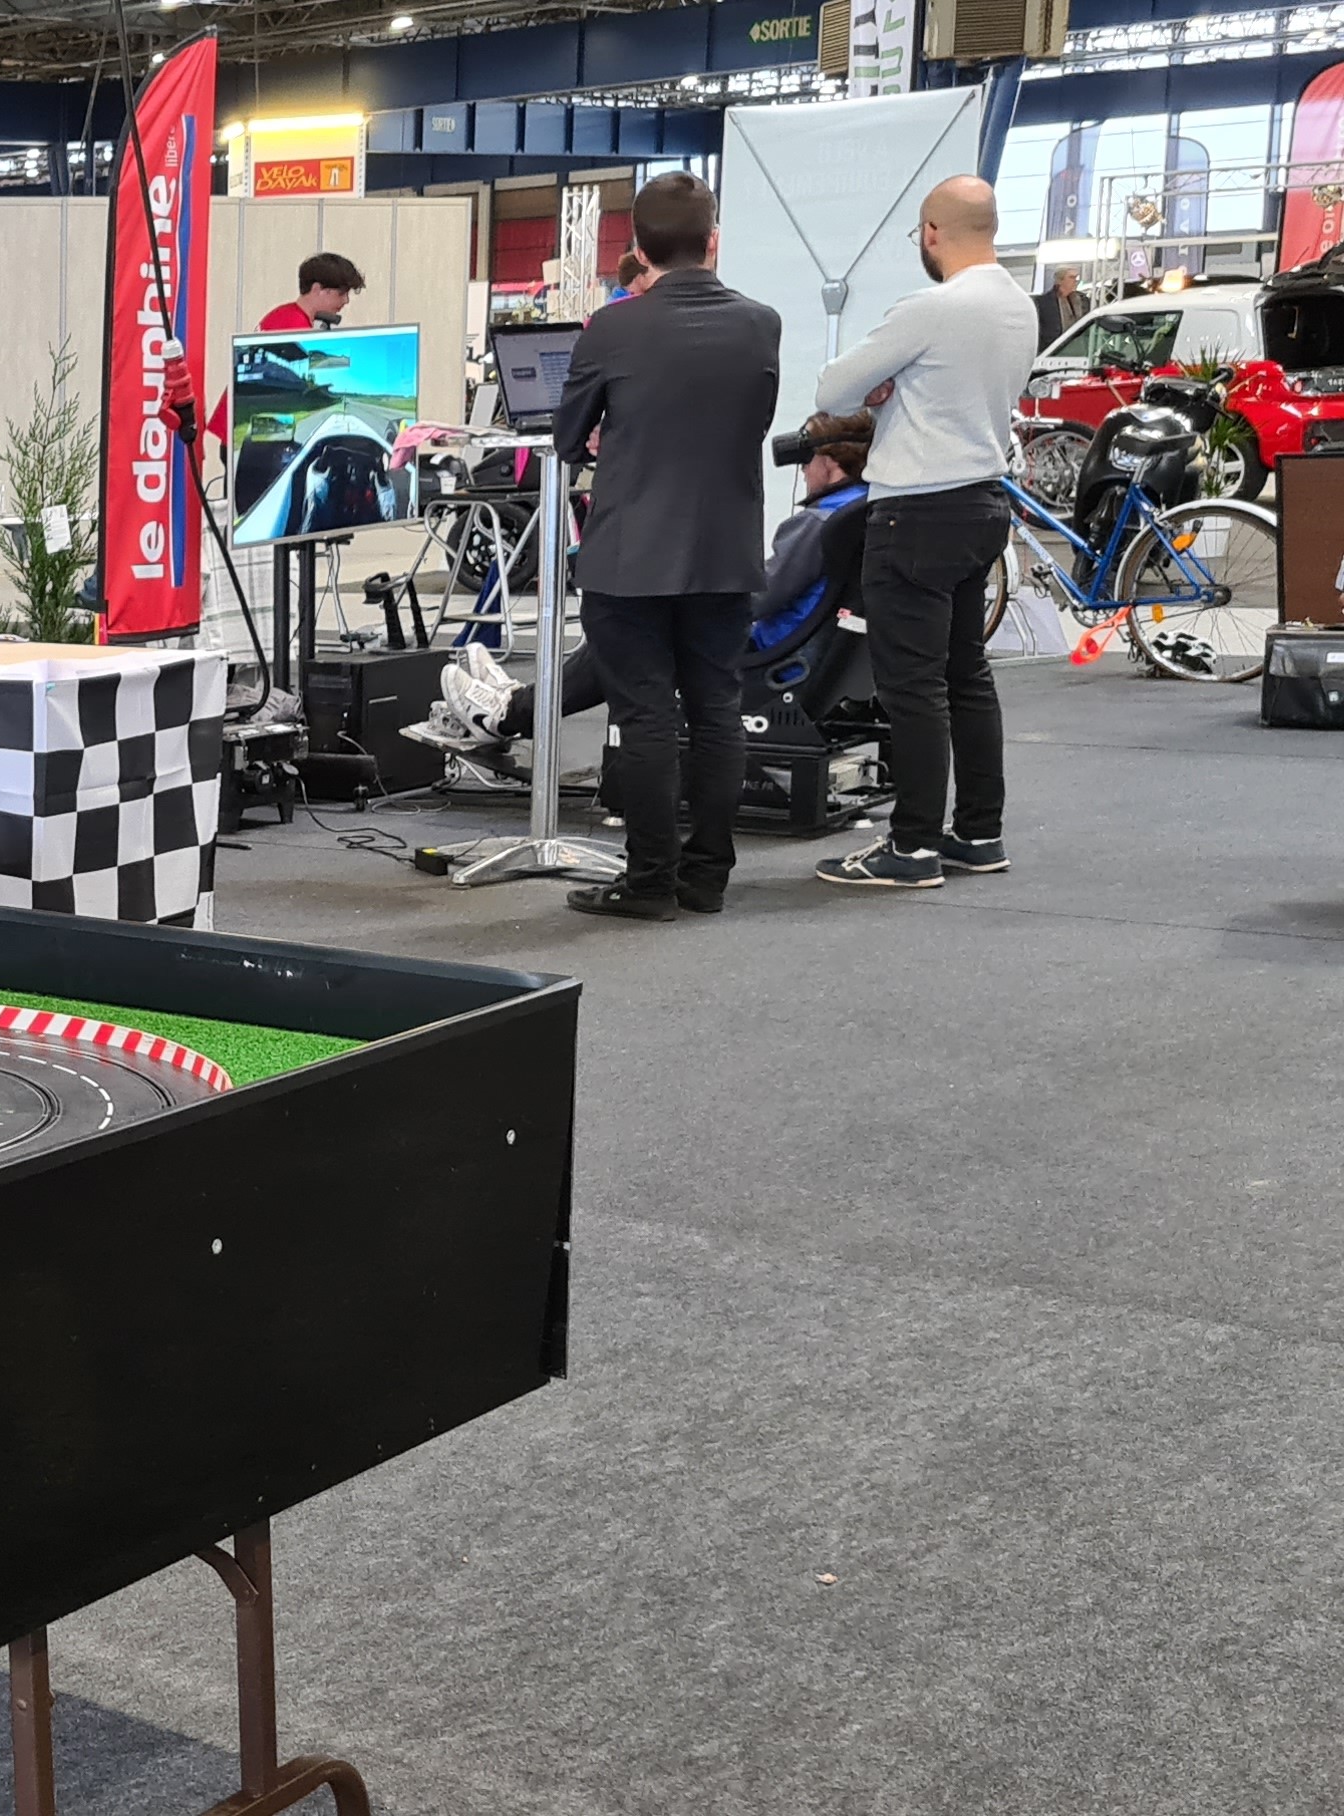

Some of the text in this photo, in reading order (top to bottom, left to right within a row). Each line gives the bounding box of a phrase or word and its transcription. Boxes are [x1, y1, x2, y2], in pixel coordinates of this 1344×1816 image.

[760, 15, 812, 42] SORTIE
[260, 164, 305, 180] VELO
[130, 521, 165, 580] le
